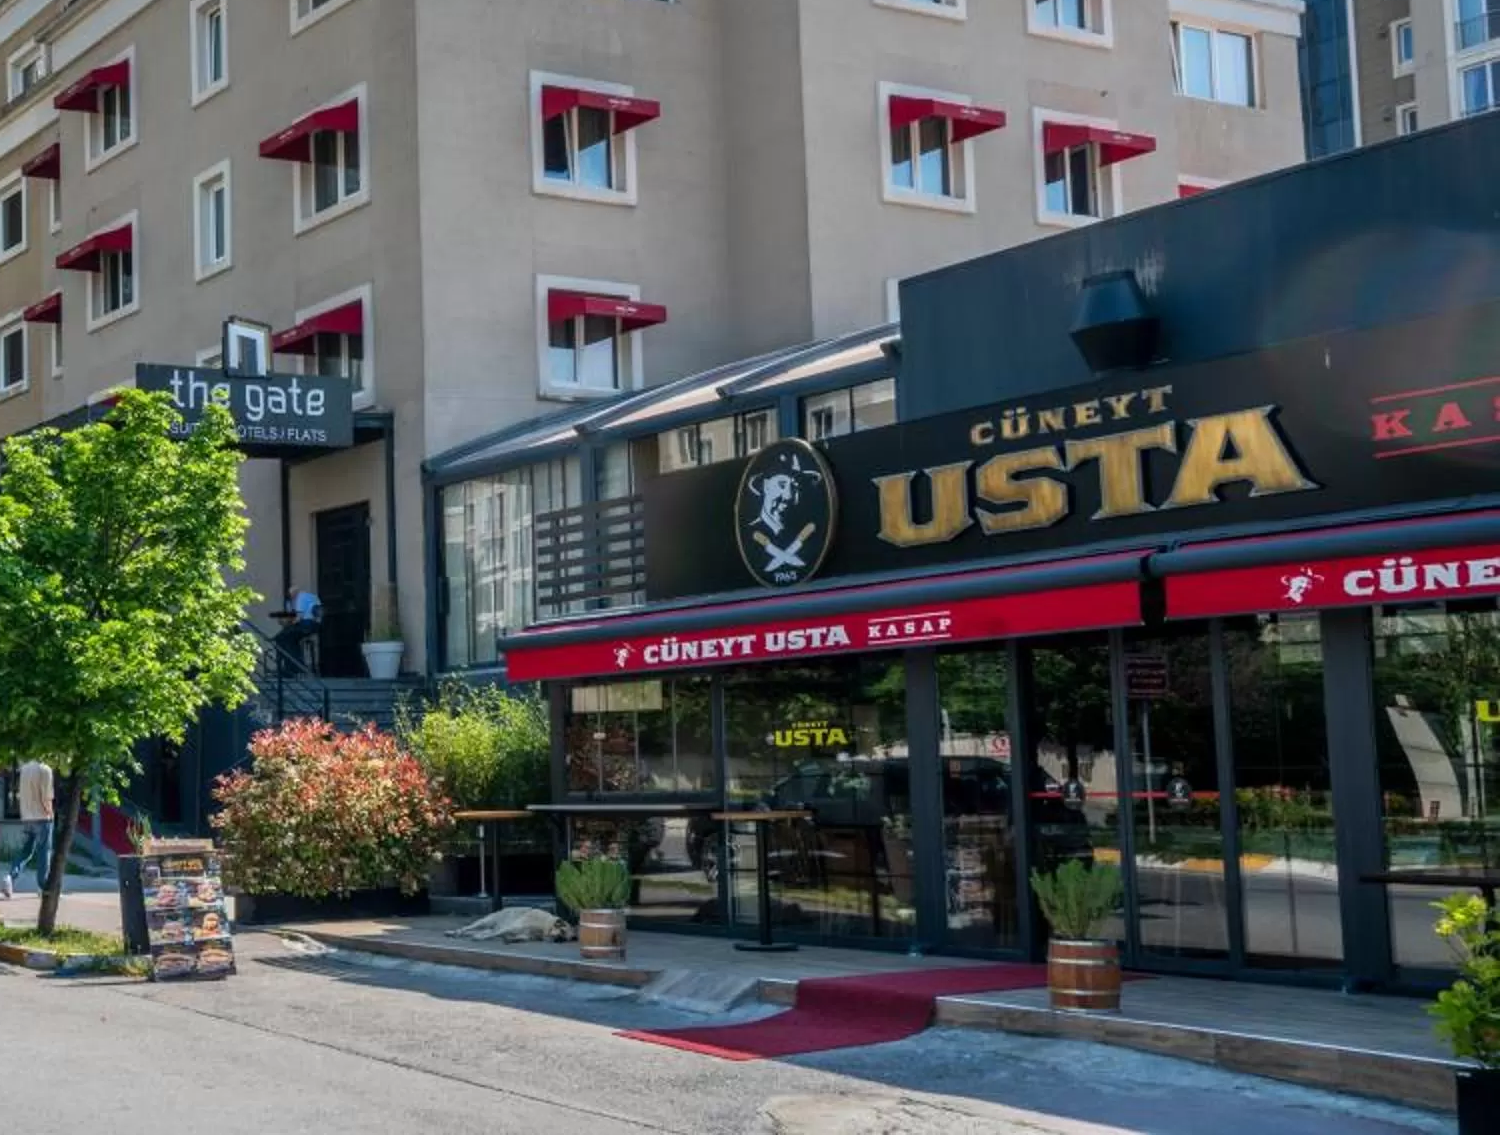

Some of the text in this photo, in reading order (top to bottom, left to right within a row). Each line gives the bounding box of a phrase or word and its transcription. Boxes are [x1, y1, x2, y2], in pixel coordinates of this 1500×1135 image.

[245, 377, 326, 421] gate
[970, 385, 1172, 446] CÜNEYT
[237, 425, 277, 441] OTELS
[288, 428, 327, 443] FLATS
[872, 403, 1320, 548] USTA
[642, 617, 952, 664] CÜNEYT USTA KASAP
[774, 728, 848, 747] USTA
